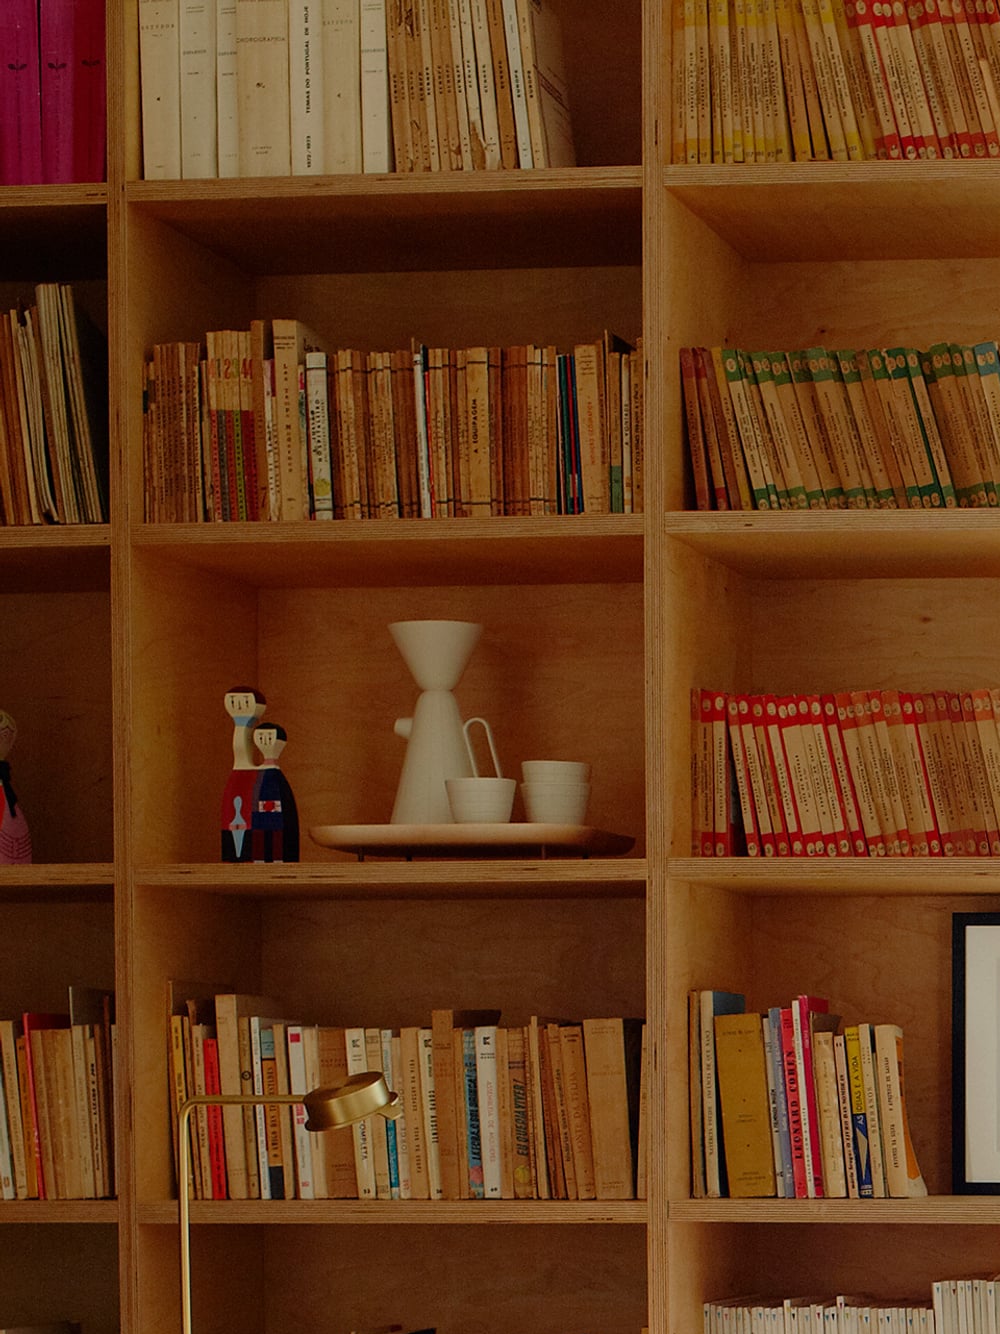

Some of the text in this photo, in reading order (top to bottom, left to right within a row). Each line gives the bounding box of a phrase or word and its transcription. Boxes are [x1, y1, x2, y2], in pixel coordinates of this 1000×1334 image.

[785, 1051, 803, 1160] LEONARD COHEN
[854, 1090, 863, 1112] IDEIAS
[866, 1086, 876, 1134] SERRANOS
[857, 1115, 865, 1125] AS
